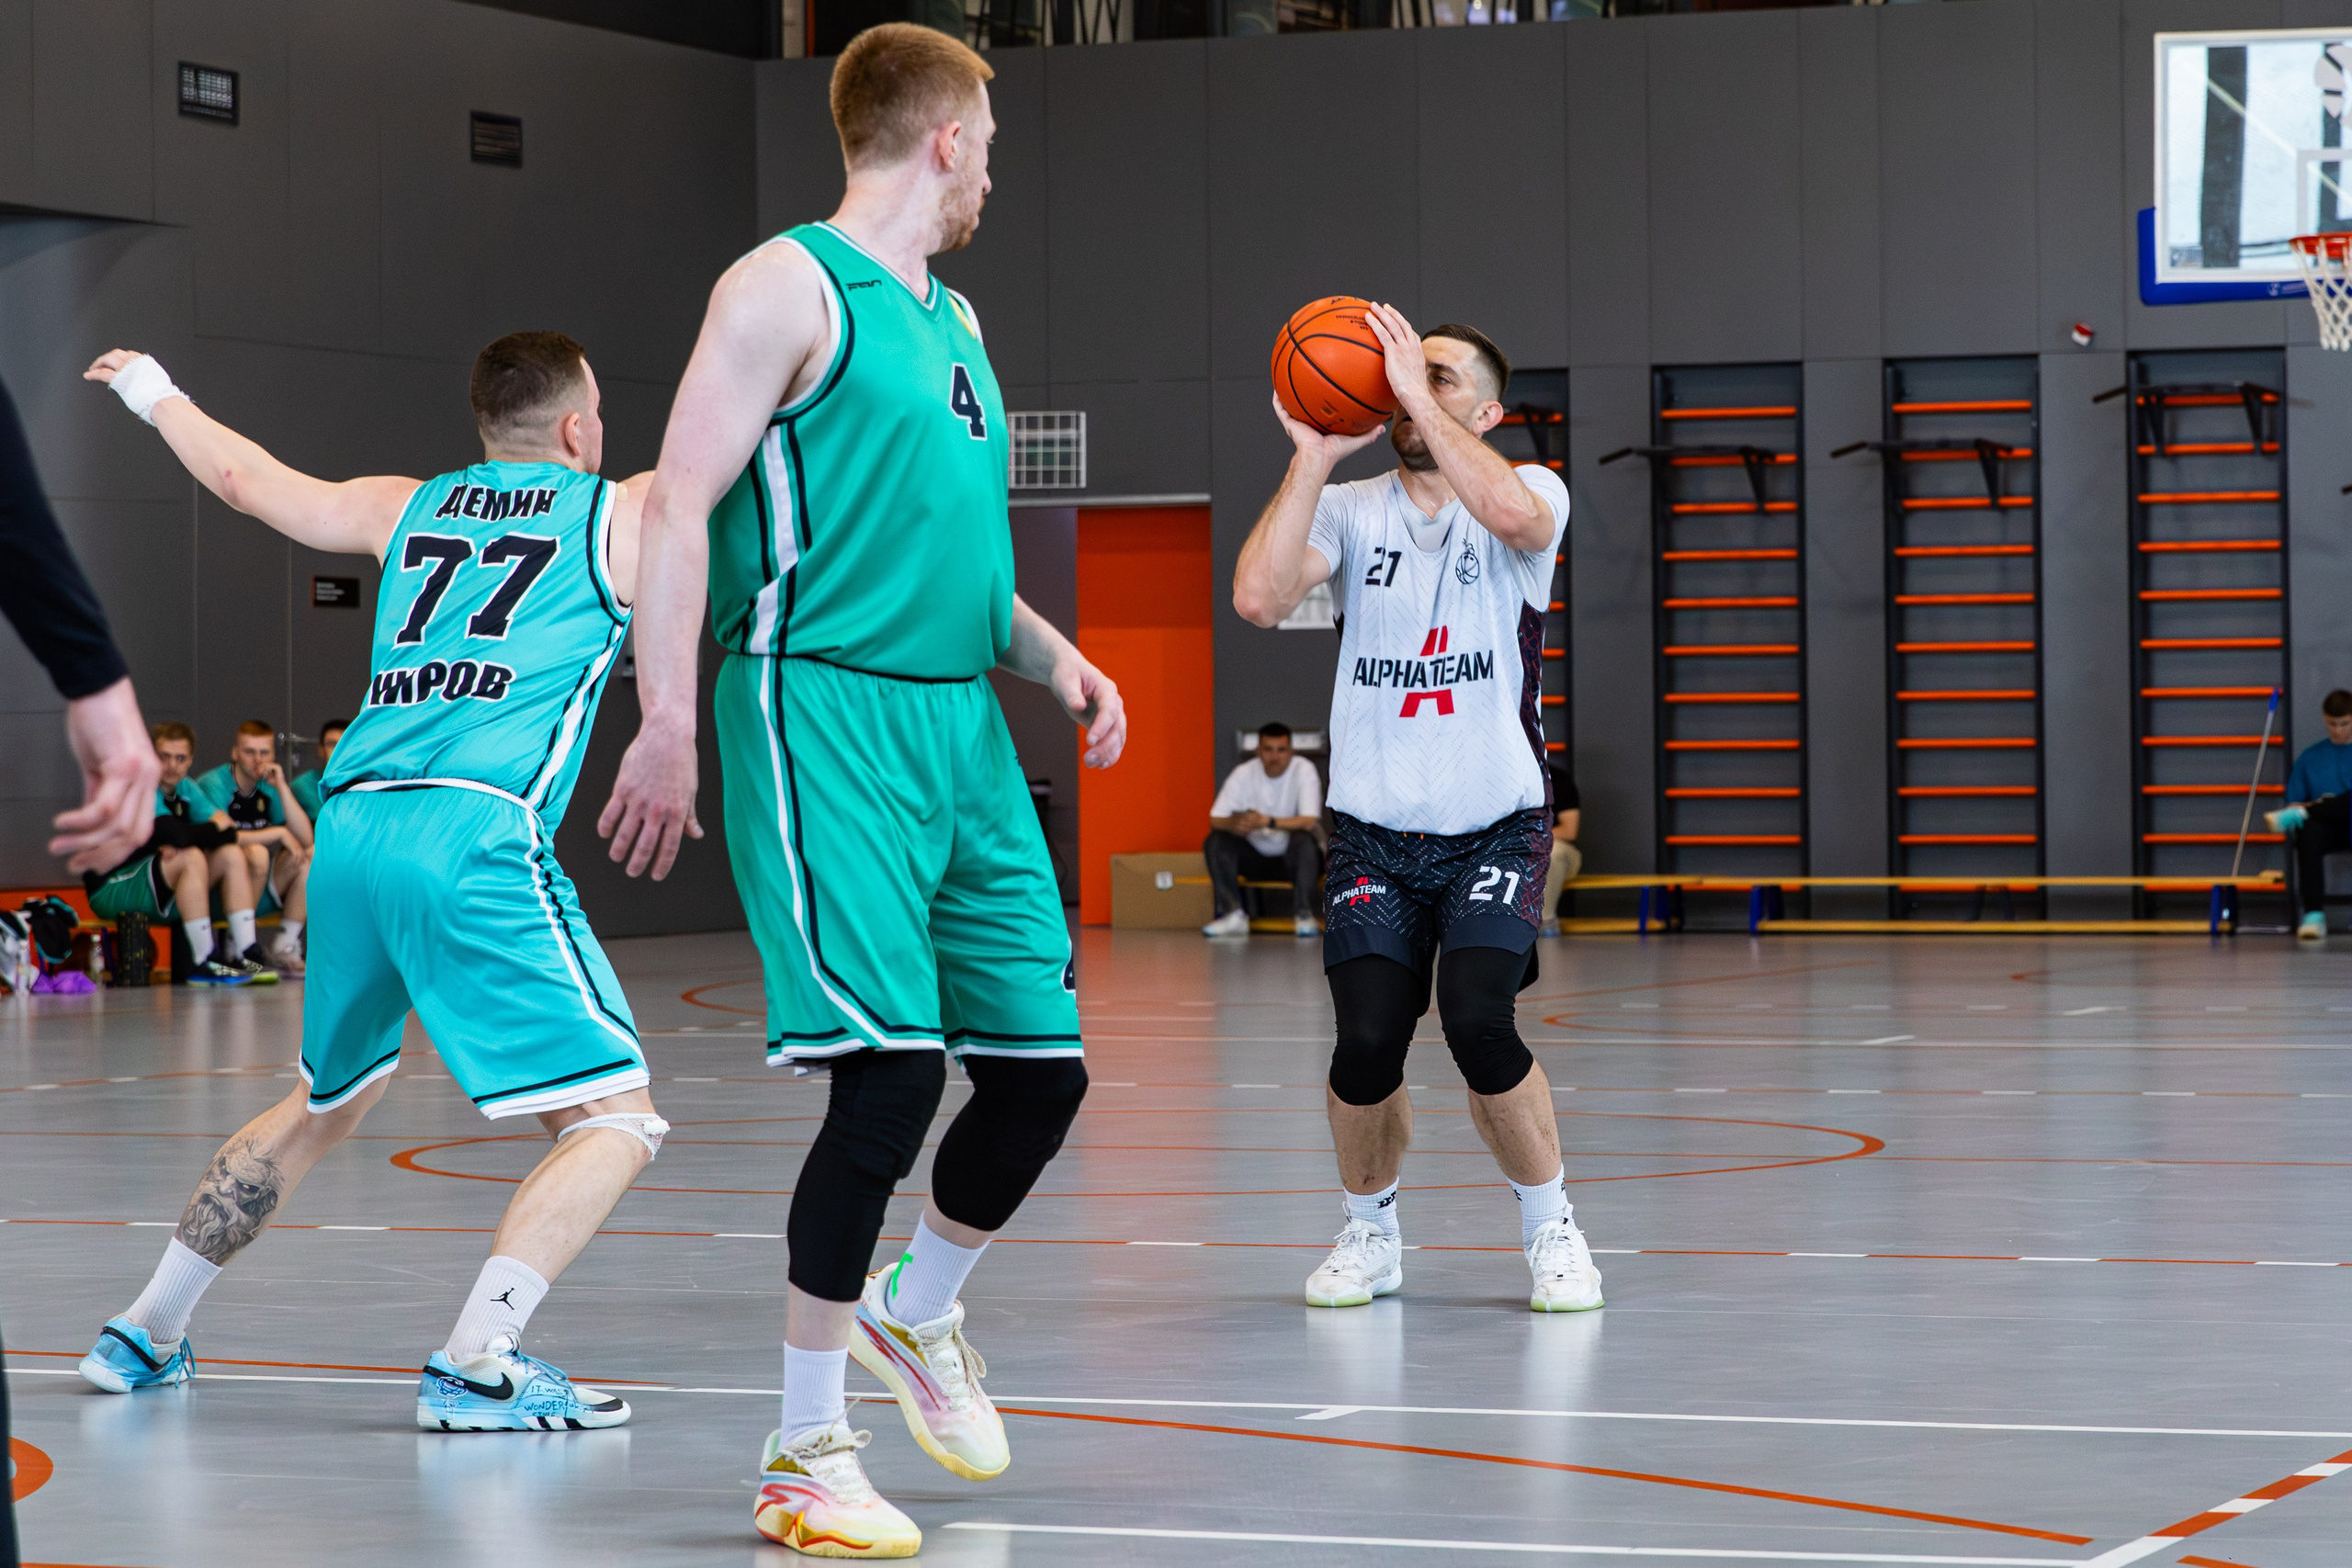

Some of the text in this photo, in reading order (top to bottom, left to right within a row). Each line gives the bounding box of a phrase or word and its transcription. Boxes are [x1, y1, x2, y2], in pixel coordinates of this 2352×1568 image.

[949, 362, 988, 441] 4
[434, 483, 558, 522] ДЕМИН
[1365, 547, 1402, 587] 21
[393, 531, 560, 648] 77
[1469, 865, 1521, 906] 21
